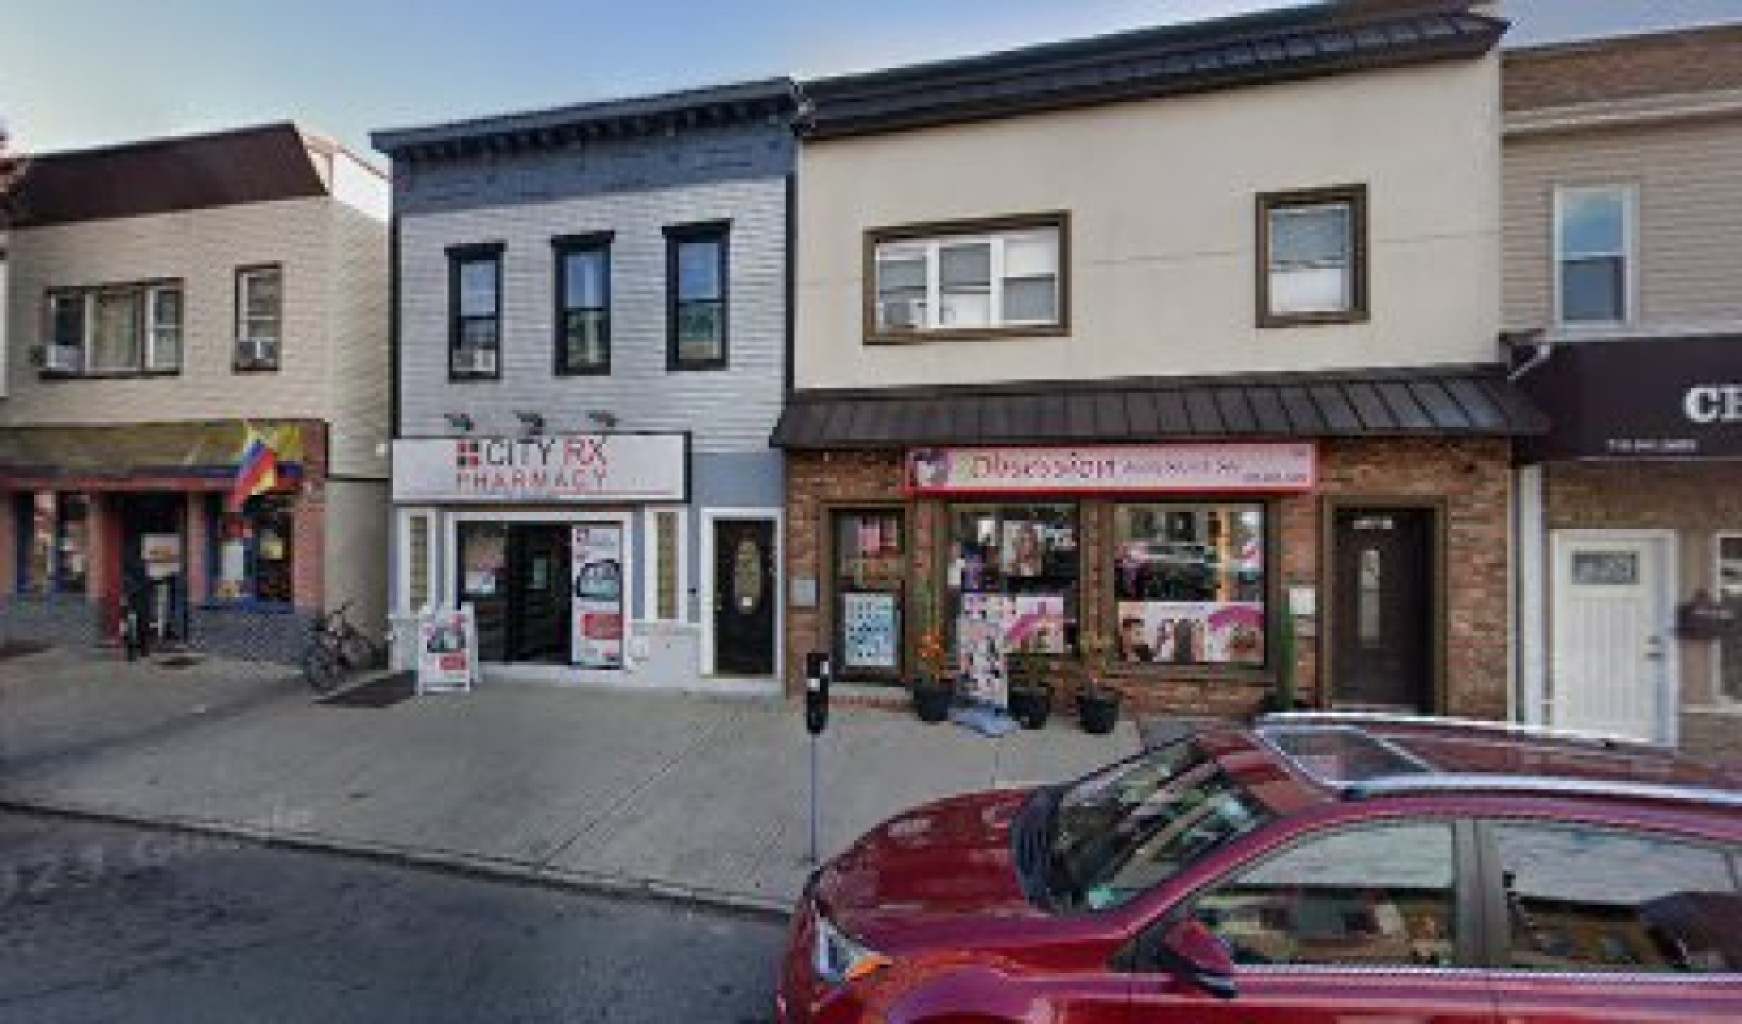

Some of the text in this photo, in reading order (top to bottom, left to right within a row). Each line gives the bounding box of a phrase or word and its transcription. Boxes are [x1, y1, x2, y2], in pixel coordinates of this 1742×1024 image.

[486, 437, 608, 467] CITY RX
[456, 470, 608, 490] PHARMACY
